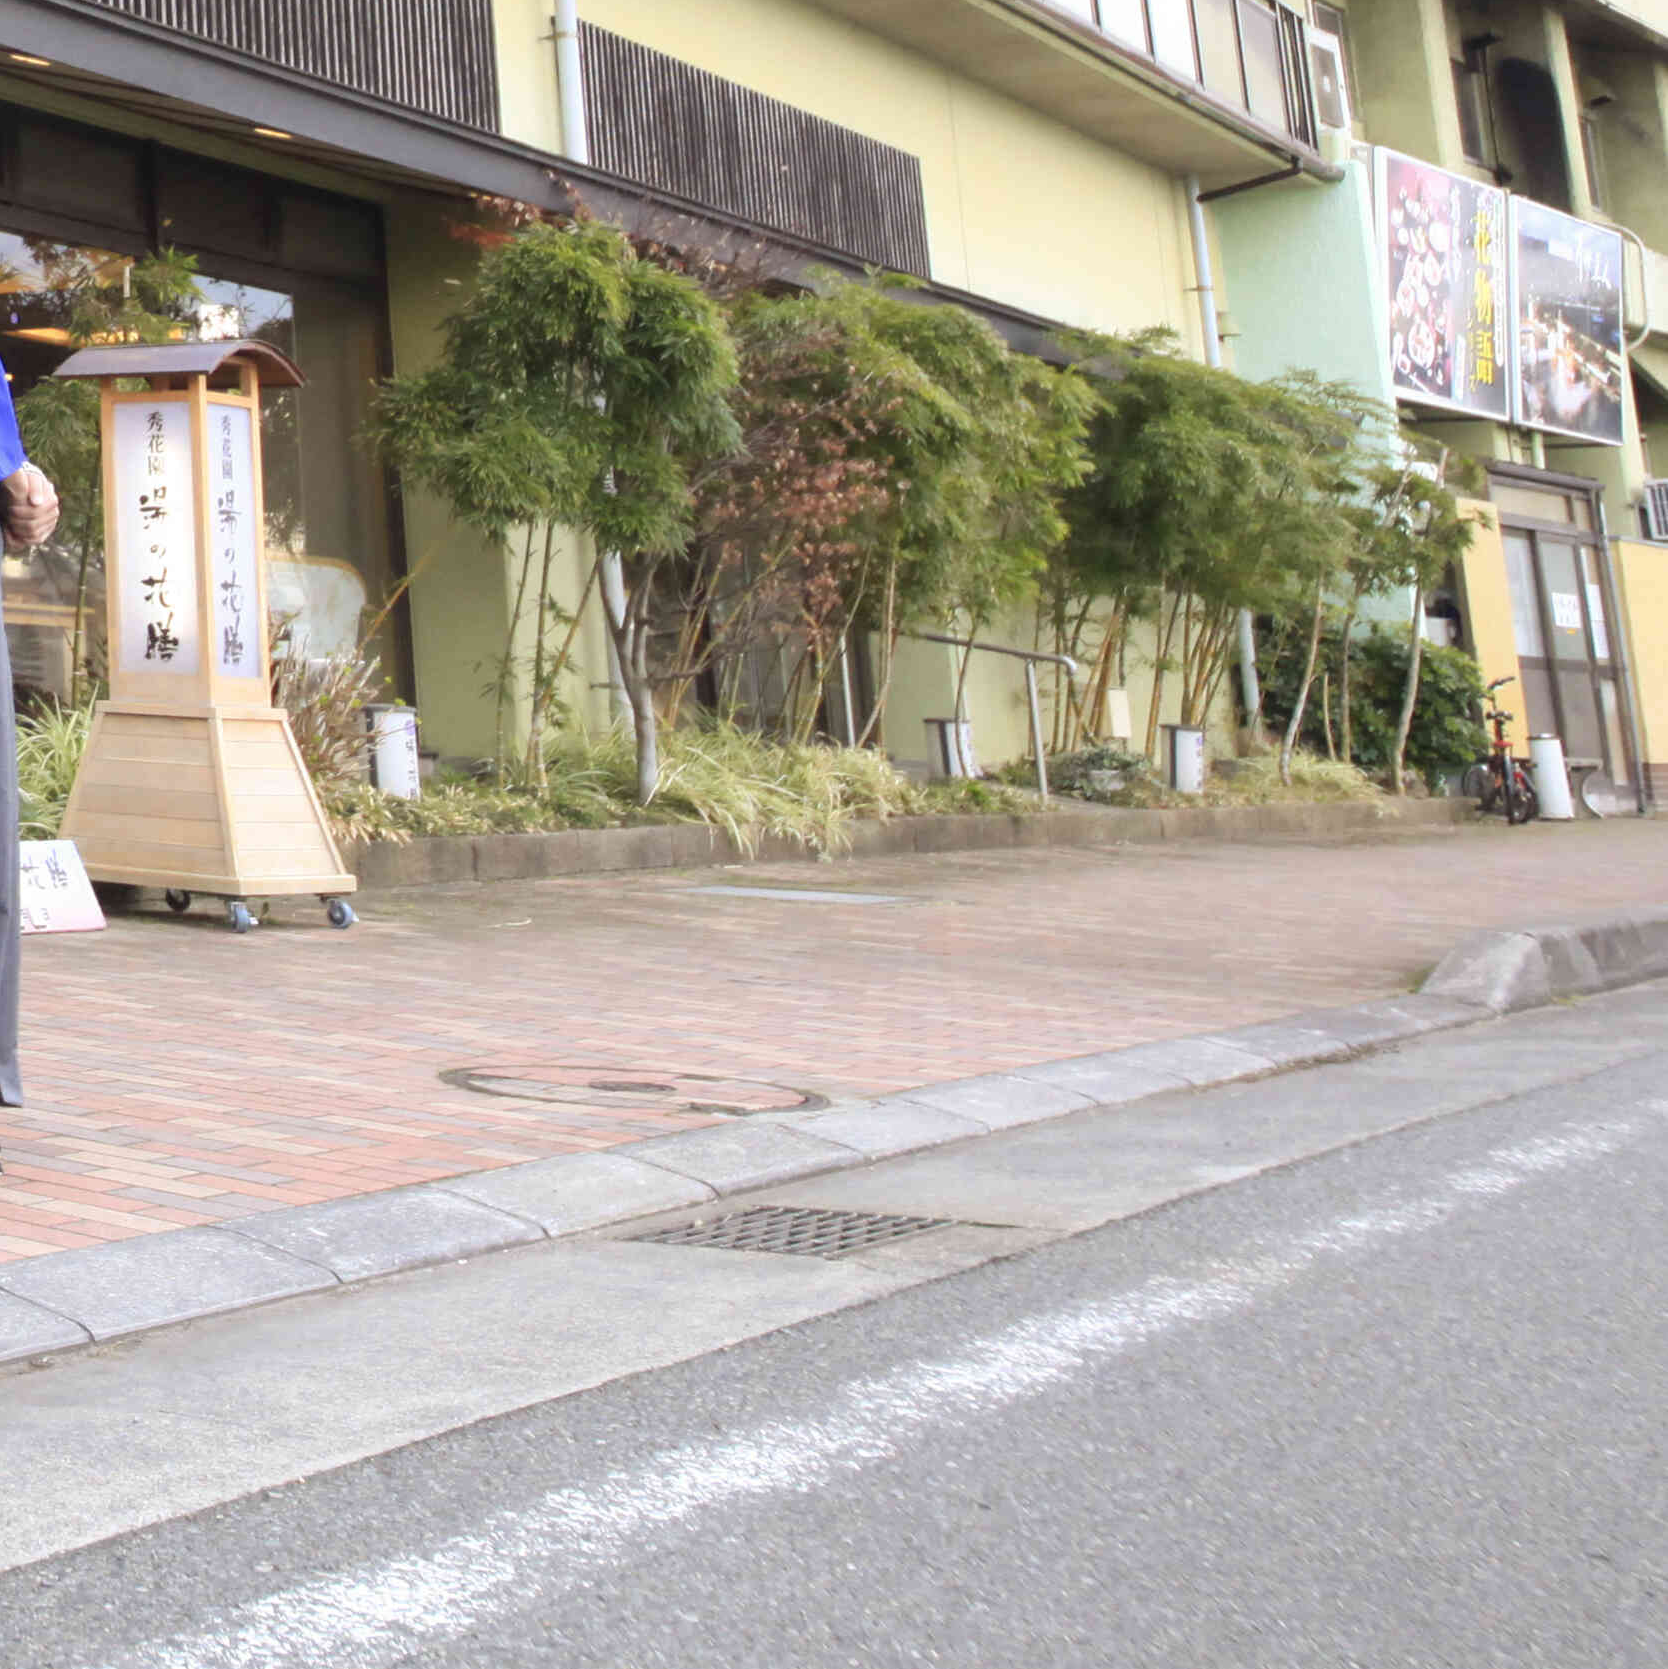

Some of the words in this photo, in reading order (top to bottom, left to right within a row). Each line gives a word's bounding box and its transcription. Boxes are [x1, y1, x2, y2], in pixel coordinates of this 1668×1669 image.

[147, 411, 165, 476] 秀花園
[138, 484, 179, 664] 湯の花膳
[217, 489, 244, 665] 湯の花膳
